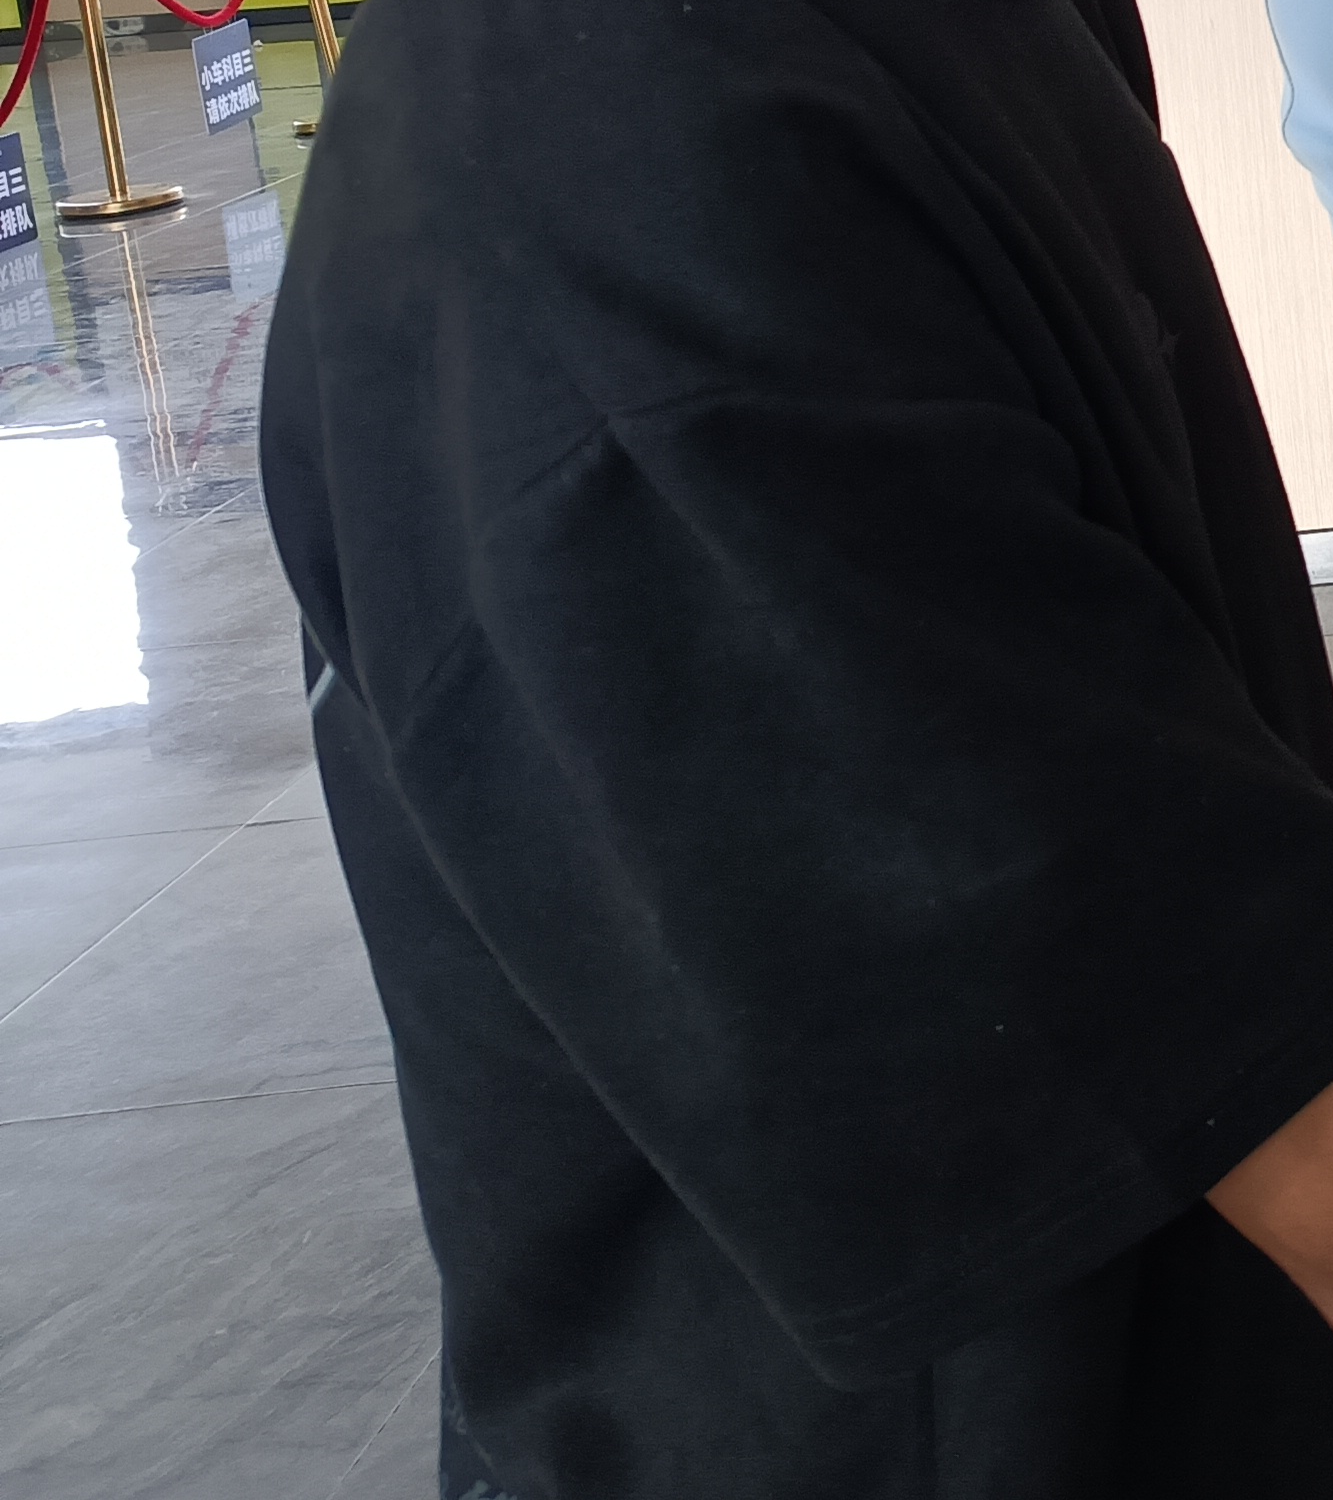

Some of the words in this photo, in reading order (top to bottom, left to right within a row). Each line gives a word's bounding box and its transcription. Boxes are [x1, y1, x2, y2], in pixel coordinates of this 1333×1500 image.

[201, 49, 254, 91] 小车科目三
[206, 79, 260, 125] 请依次排队
[0, 202, 34, 240] 排队
